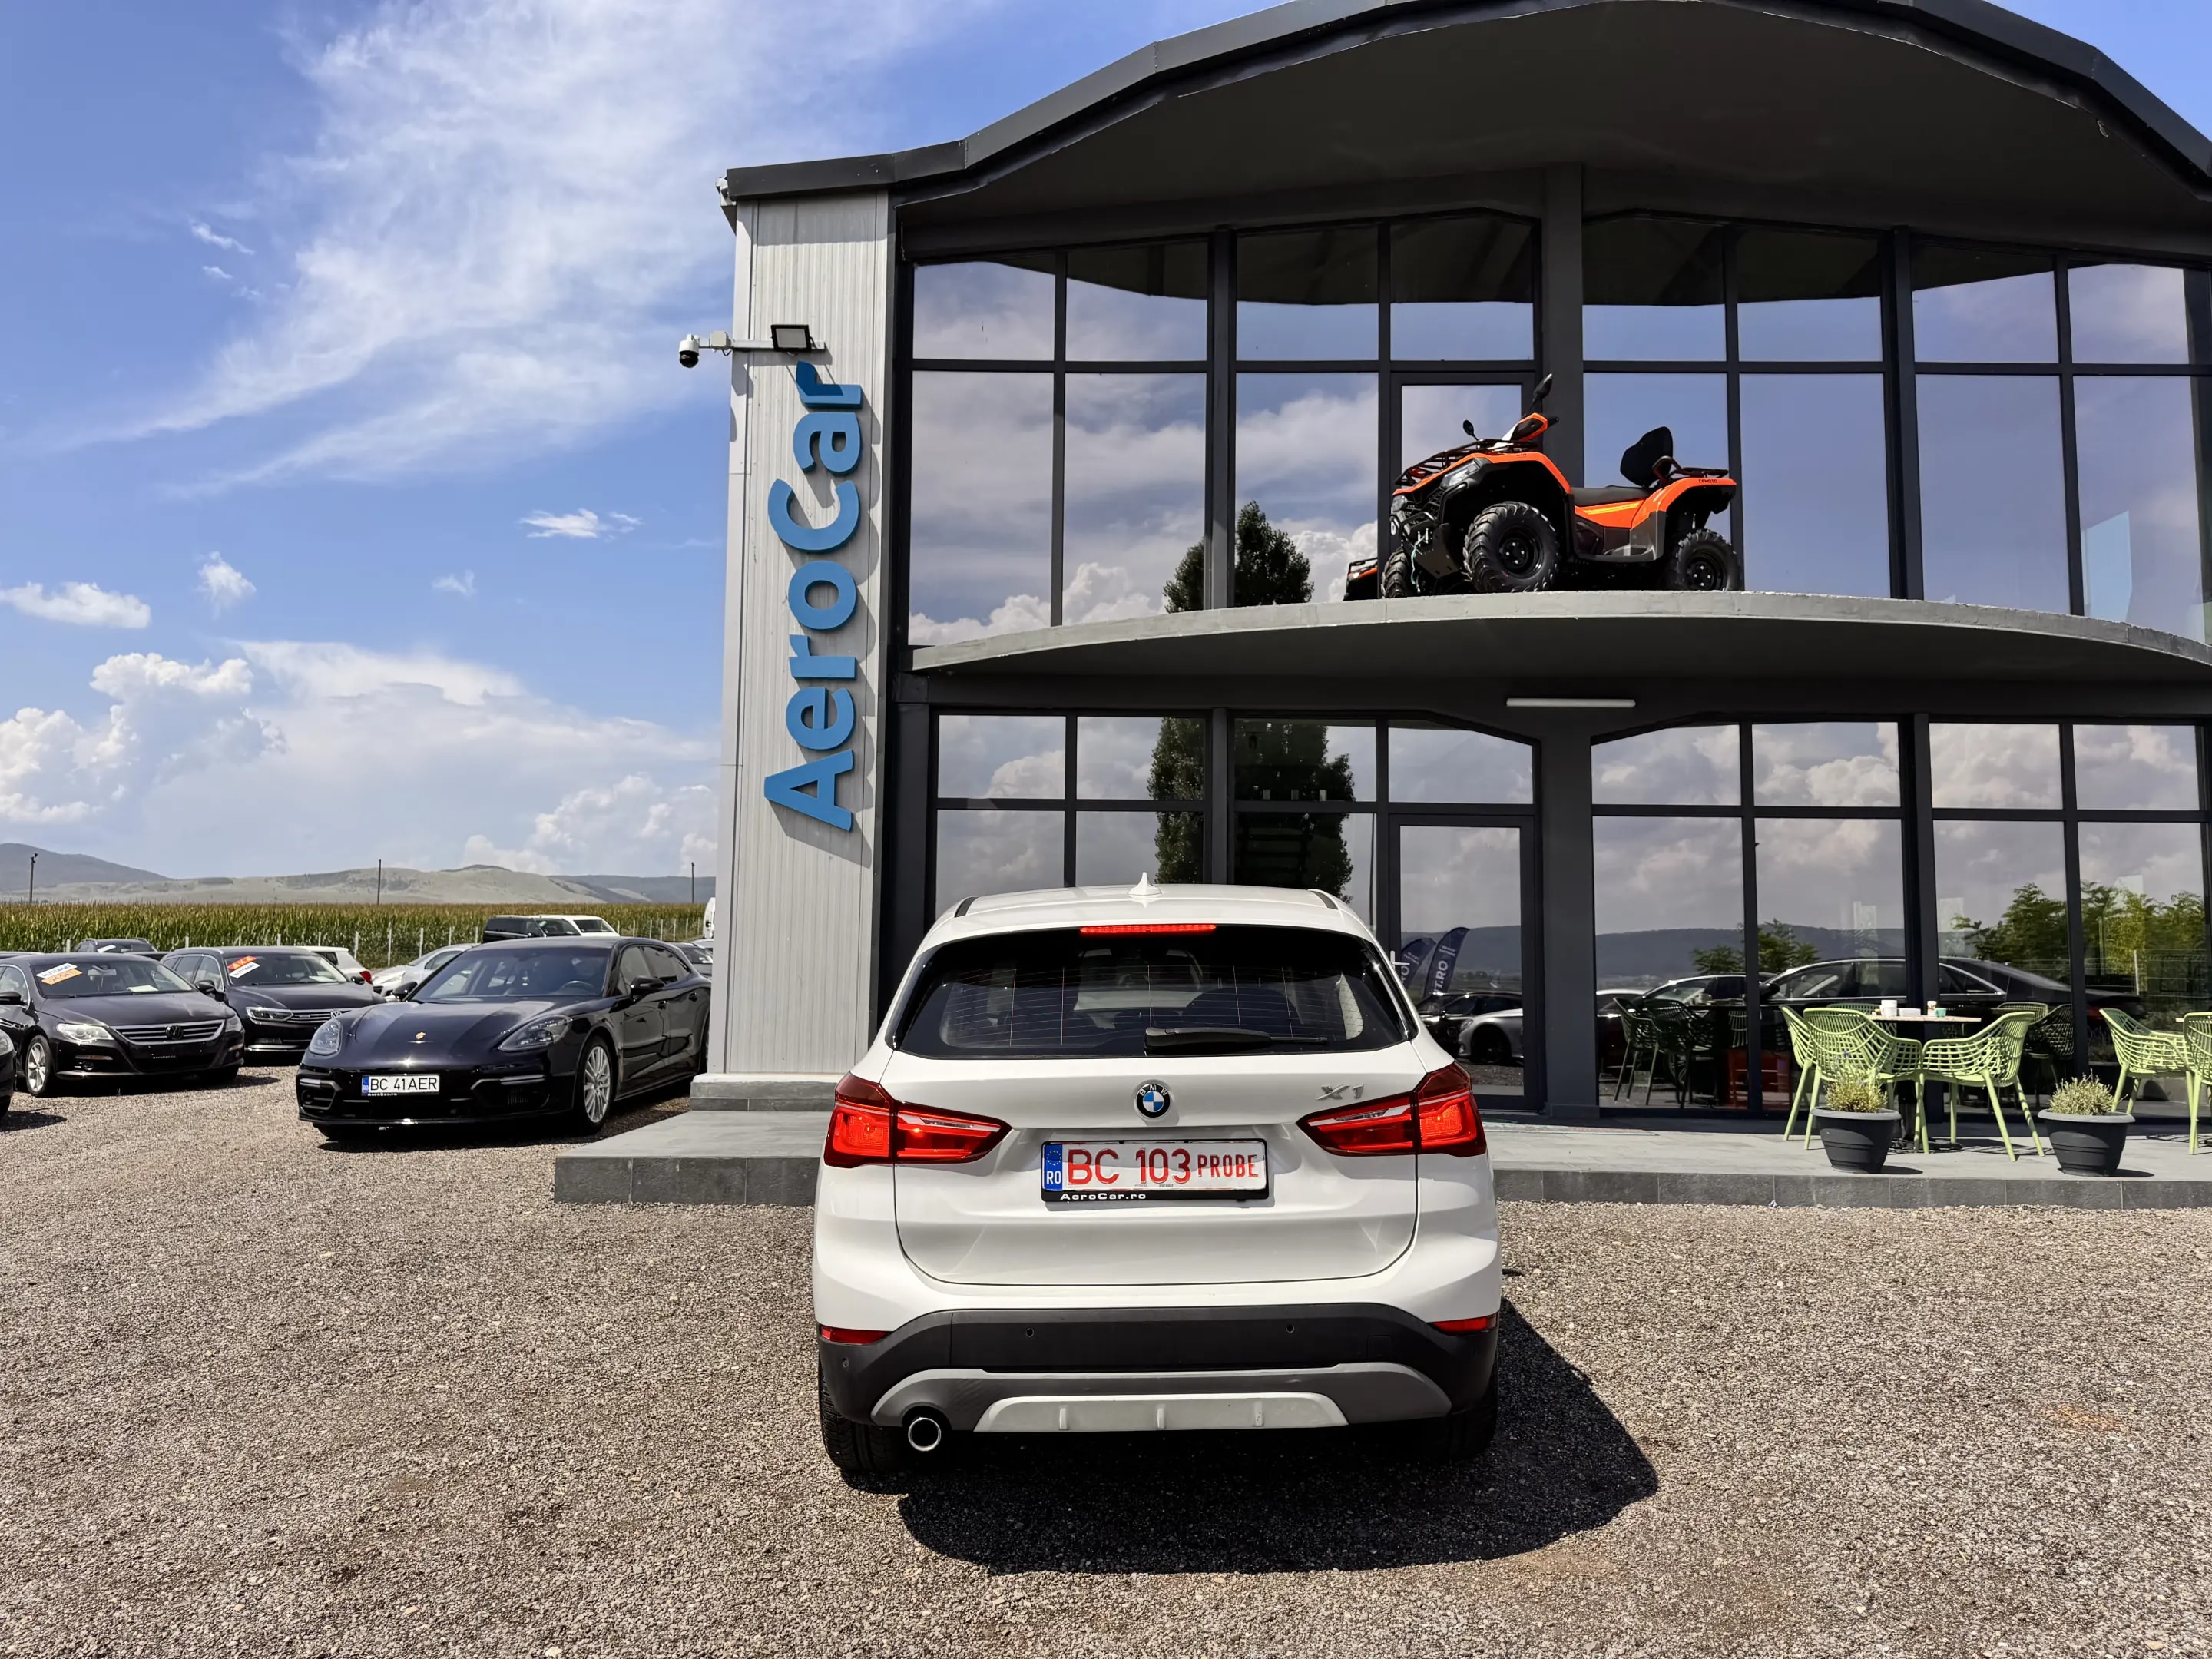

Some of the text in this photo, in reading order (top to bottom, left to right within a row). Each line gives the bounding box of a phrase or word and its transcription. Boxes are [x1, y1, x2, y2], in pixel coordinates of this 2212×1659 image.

[764, 361, 863, 831] AeroCar
[370, 1078, 437, 1091] BC 41AER
[1138, 1084, 1168, 1097] BMW
[1315, 1084, 1364, 1101] X1
[1068, 1147, 1259, 1184] BC 103 PROBE
[1046, 1170, 1061, 1184] RO
[1060, 1192, 1147, 1200] AeroCar.ro
